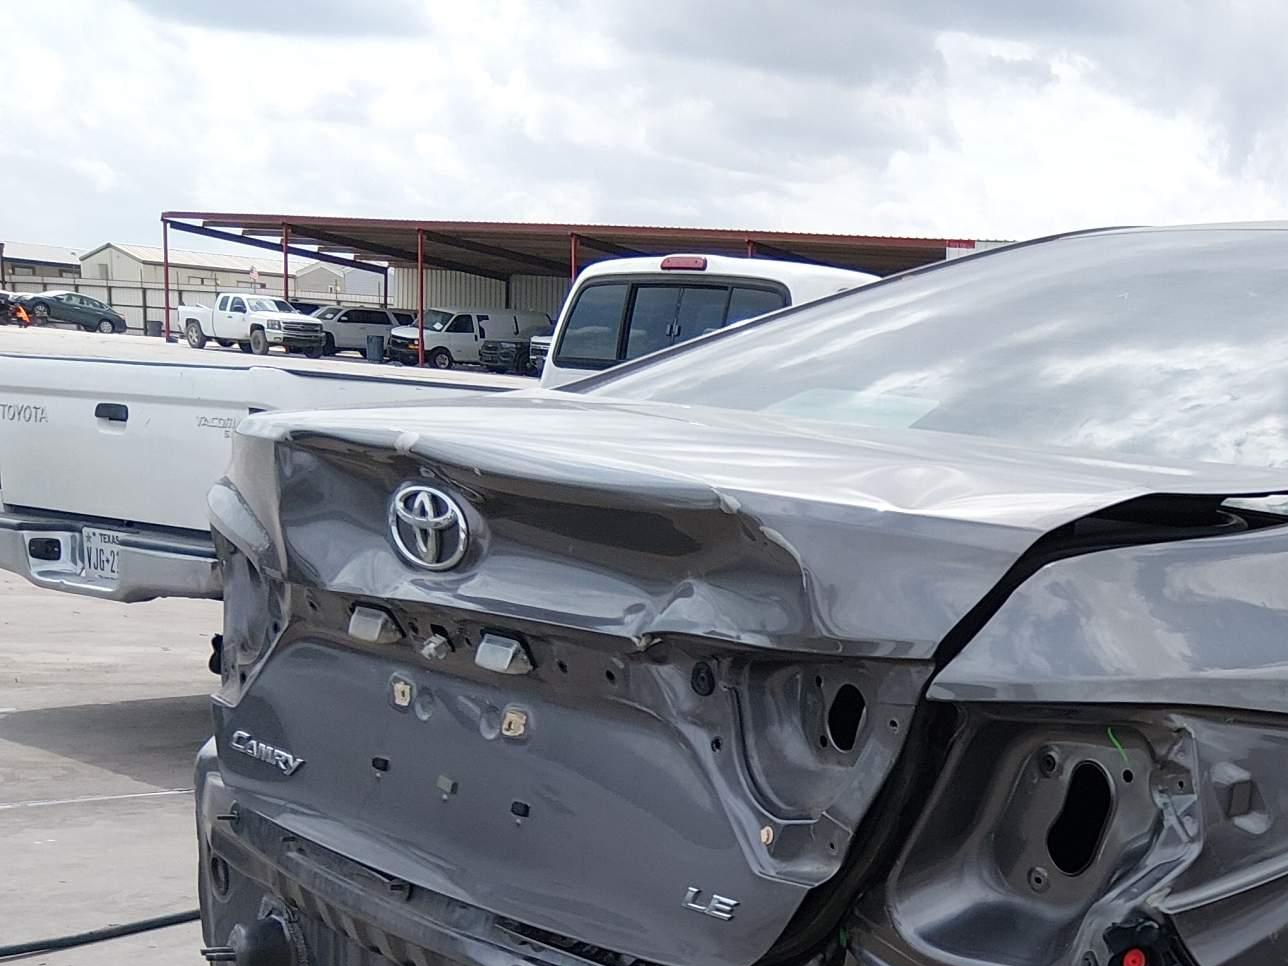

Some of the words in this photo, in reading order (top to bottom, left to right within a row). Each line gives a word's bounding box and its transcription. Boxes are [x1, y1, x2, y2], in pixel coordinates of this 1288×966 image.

[0, 403, 48, 423] TOYOTA
[99, 532, 120, 545] TEXAS
[231, 730, 305, 776] CAMRY
[681, 886, 740, 921] LE
